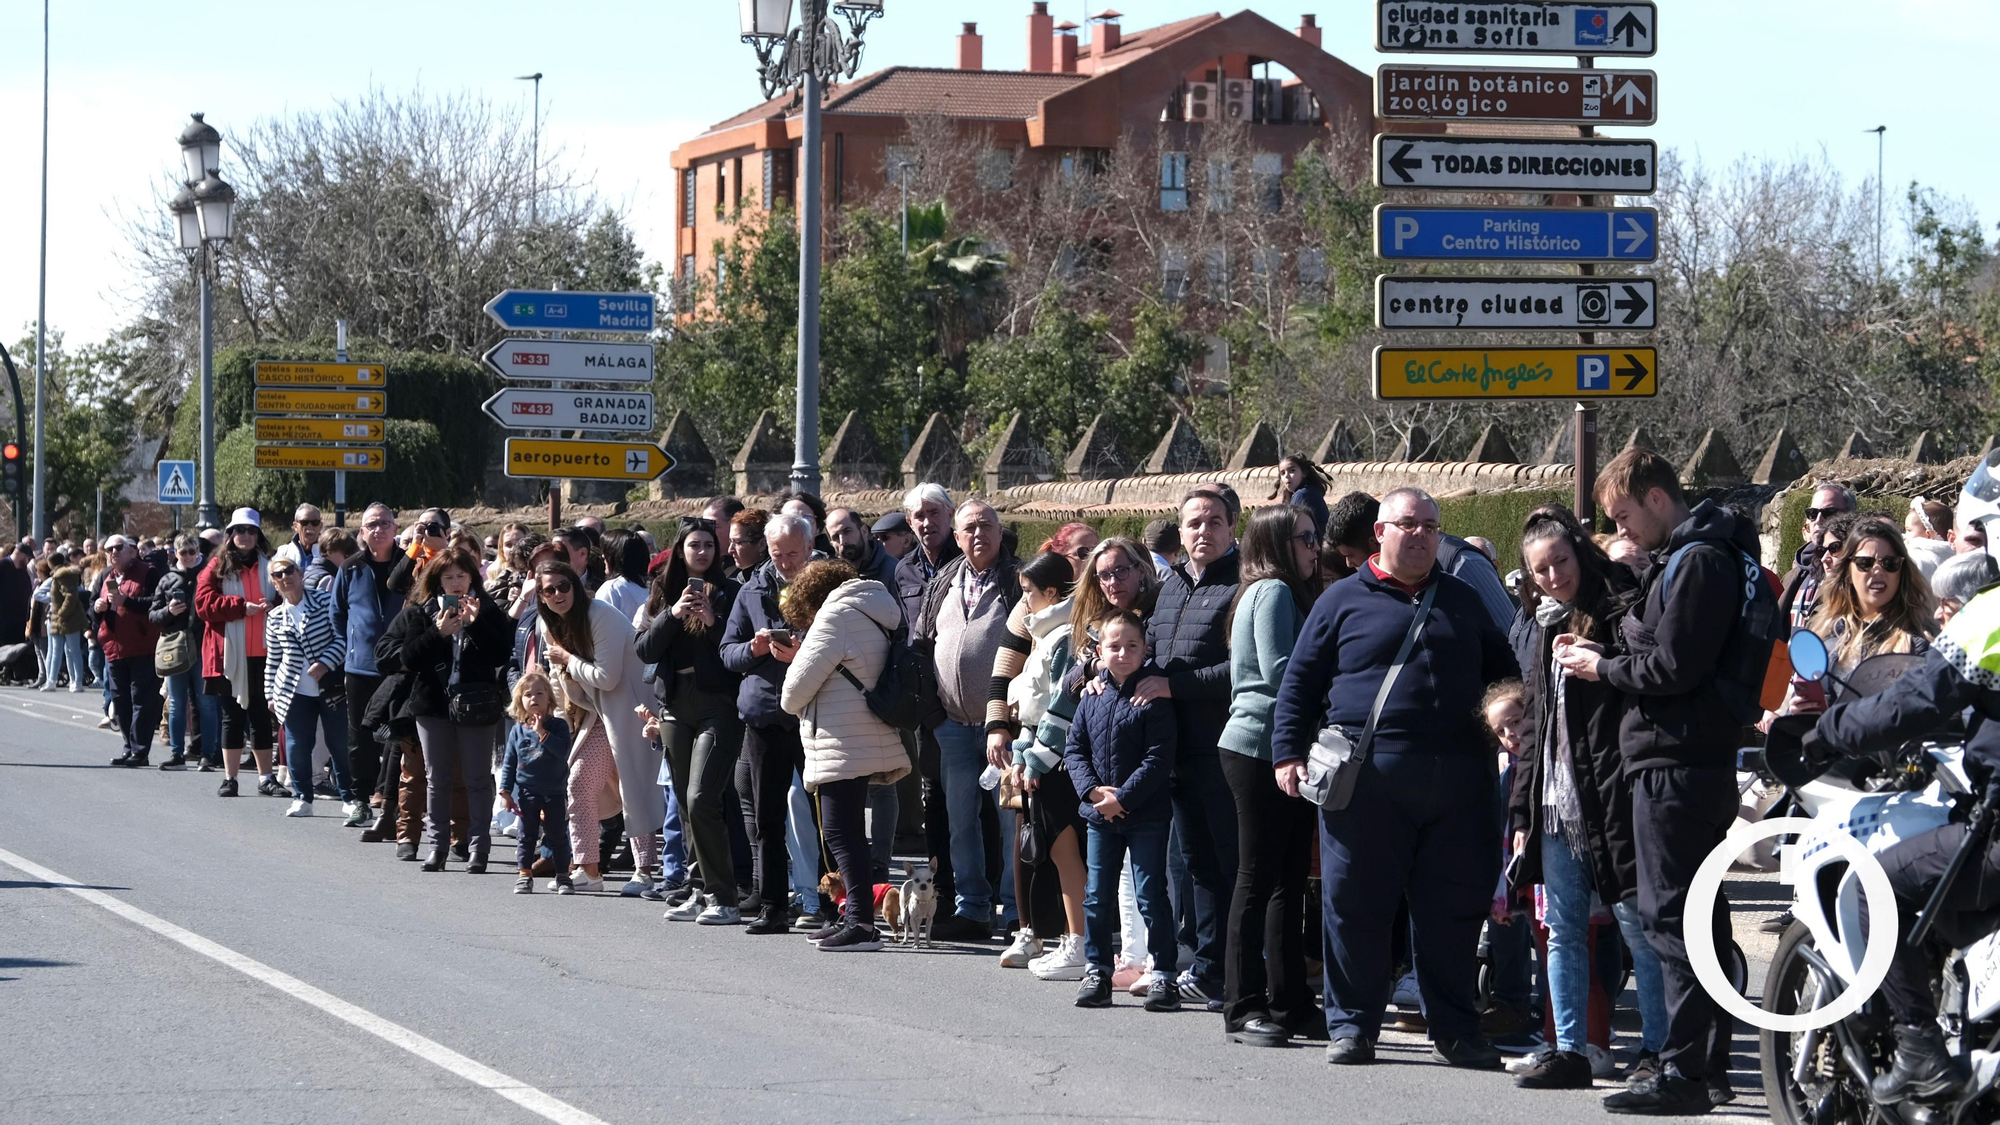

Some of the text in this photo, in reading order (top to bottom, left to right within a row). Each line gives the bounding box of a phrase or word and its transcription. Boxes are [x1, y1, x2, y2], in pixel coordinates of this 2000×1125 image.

[1387, 6, 1458, 25] ciudad
[1474, 27, 1538, 45] Sofía
[1389, 73, 1570, 95] jardín botánico
[1390, 96, 1507, 116] zoológico
[1431, 154, 1646, 178] TODAS DIRECCIONES
[1394, 216, 1420, 250] P
[1483, 218, 1540, 234] Parking
[1442, 235, 1581, 252] Centro Histórico
[598, 299, 648, 311] Sevilla
[1389, 294, 1563, 314] centro ciudad
[599, 314, 649, 327] Madrid
[513, 354, 549, 365] N-331
[585, 354, 647, 368] MÁLAGA
[257, 374, 345, 383] CASCO HISTÓRICO
[1404, 353, 1554, 392] El Corte Inglés
[1583, 358, 1605, 388] P
[257, 402, 292, 410] CENTRO
[512, 404, 552, 415] N-432
[574, 397, 646, 410] GRANADA
[580, 413, 646, 425] BADAJOZ
[282, 432, 323, 440] MEZQUITA
[257, 449, 279, 457] hotel
[513, 452, 610, 466] aeropuerto
